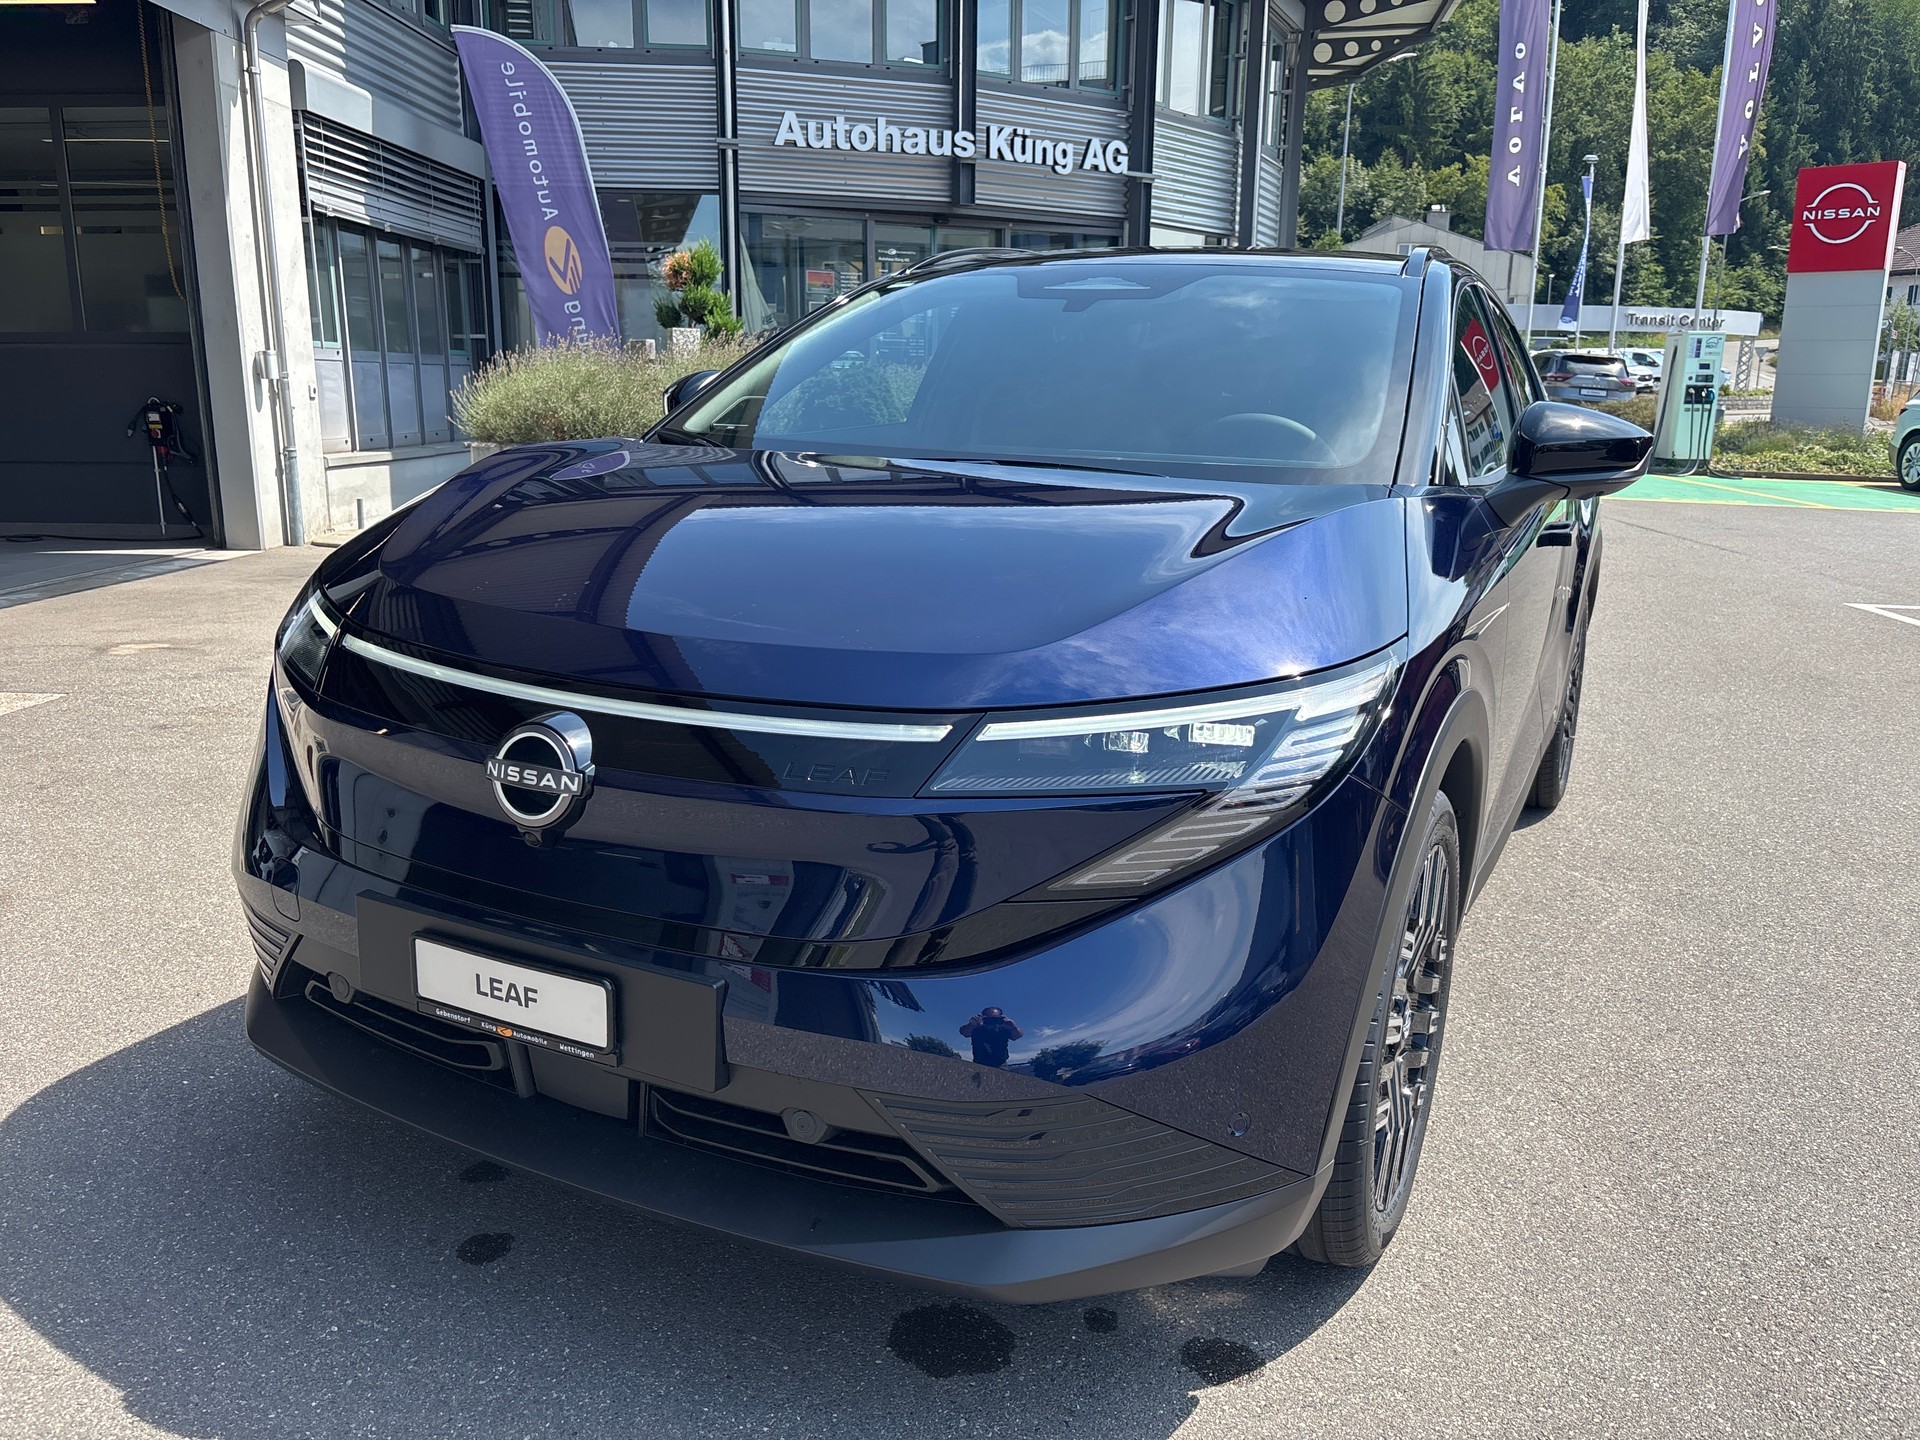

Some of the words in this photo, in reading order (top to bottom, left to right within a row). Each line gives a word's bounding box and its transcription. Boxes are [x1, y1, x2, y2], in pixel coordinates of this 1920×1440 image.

[1738, 0, 1764, 159] VOLV
[774, 110, 975, 158] Autohaus
[987, 125, 1074, 175] Küng
[1083, 138, 1129, 174] AG
[1802, 206, 1881, 221] NISSAN
[1627, 312, 1675, 326] Transit
[1680, 314, 1725, 328] Center
[487, 760, 579, 792] NISSAN
[783, 761, 890, 786] LEAF
[475, 973, 538, 1009] LEAF
[435, 1008, 471, 1024] Gebenstorf
[481, 1021, 497, 1032] Küng
[513, 1031, 548, 1046] Automobile
[559, 1042, 595, 1059] Wettingen
